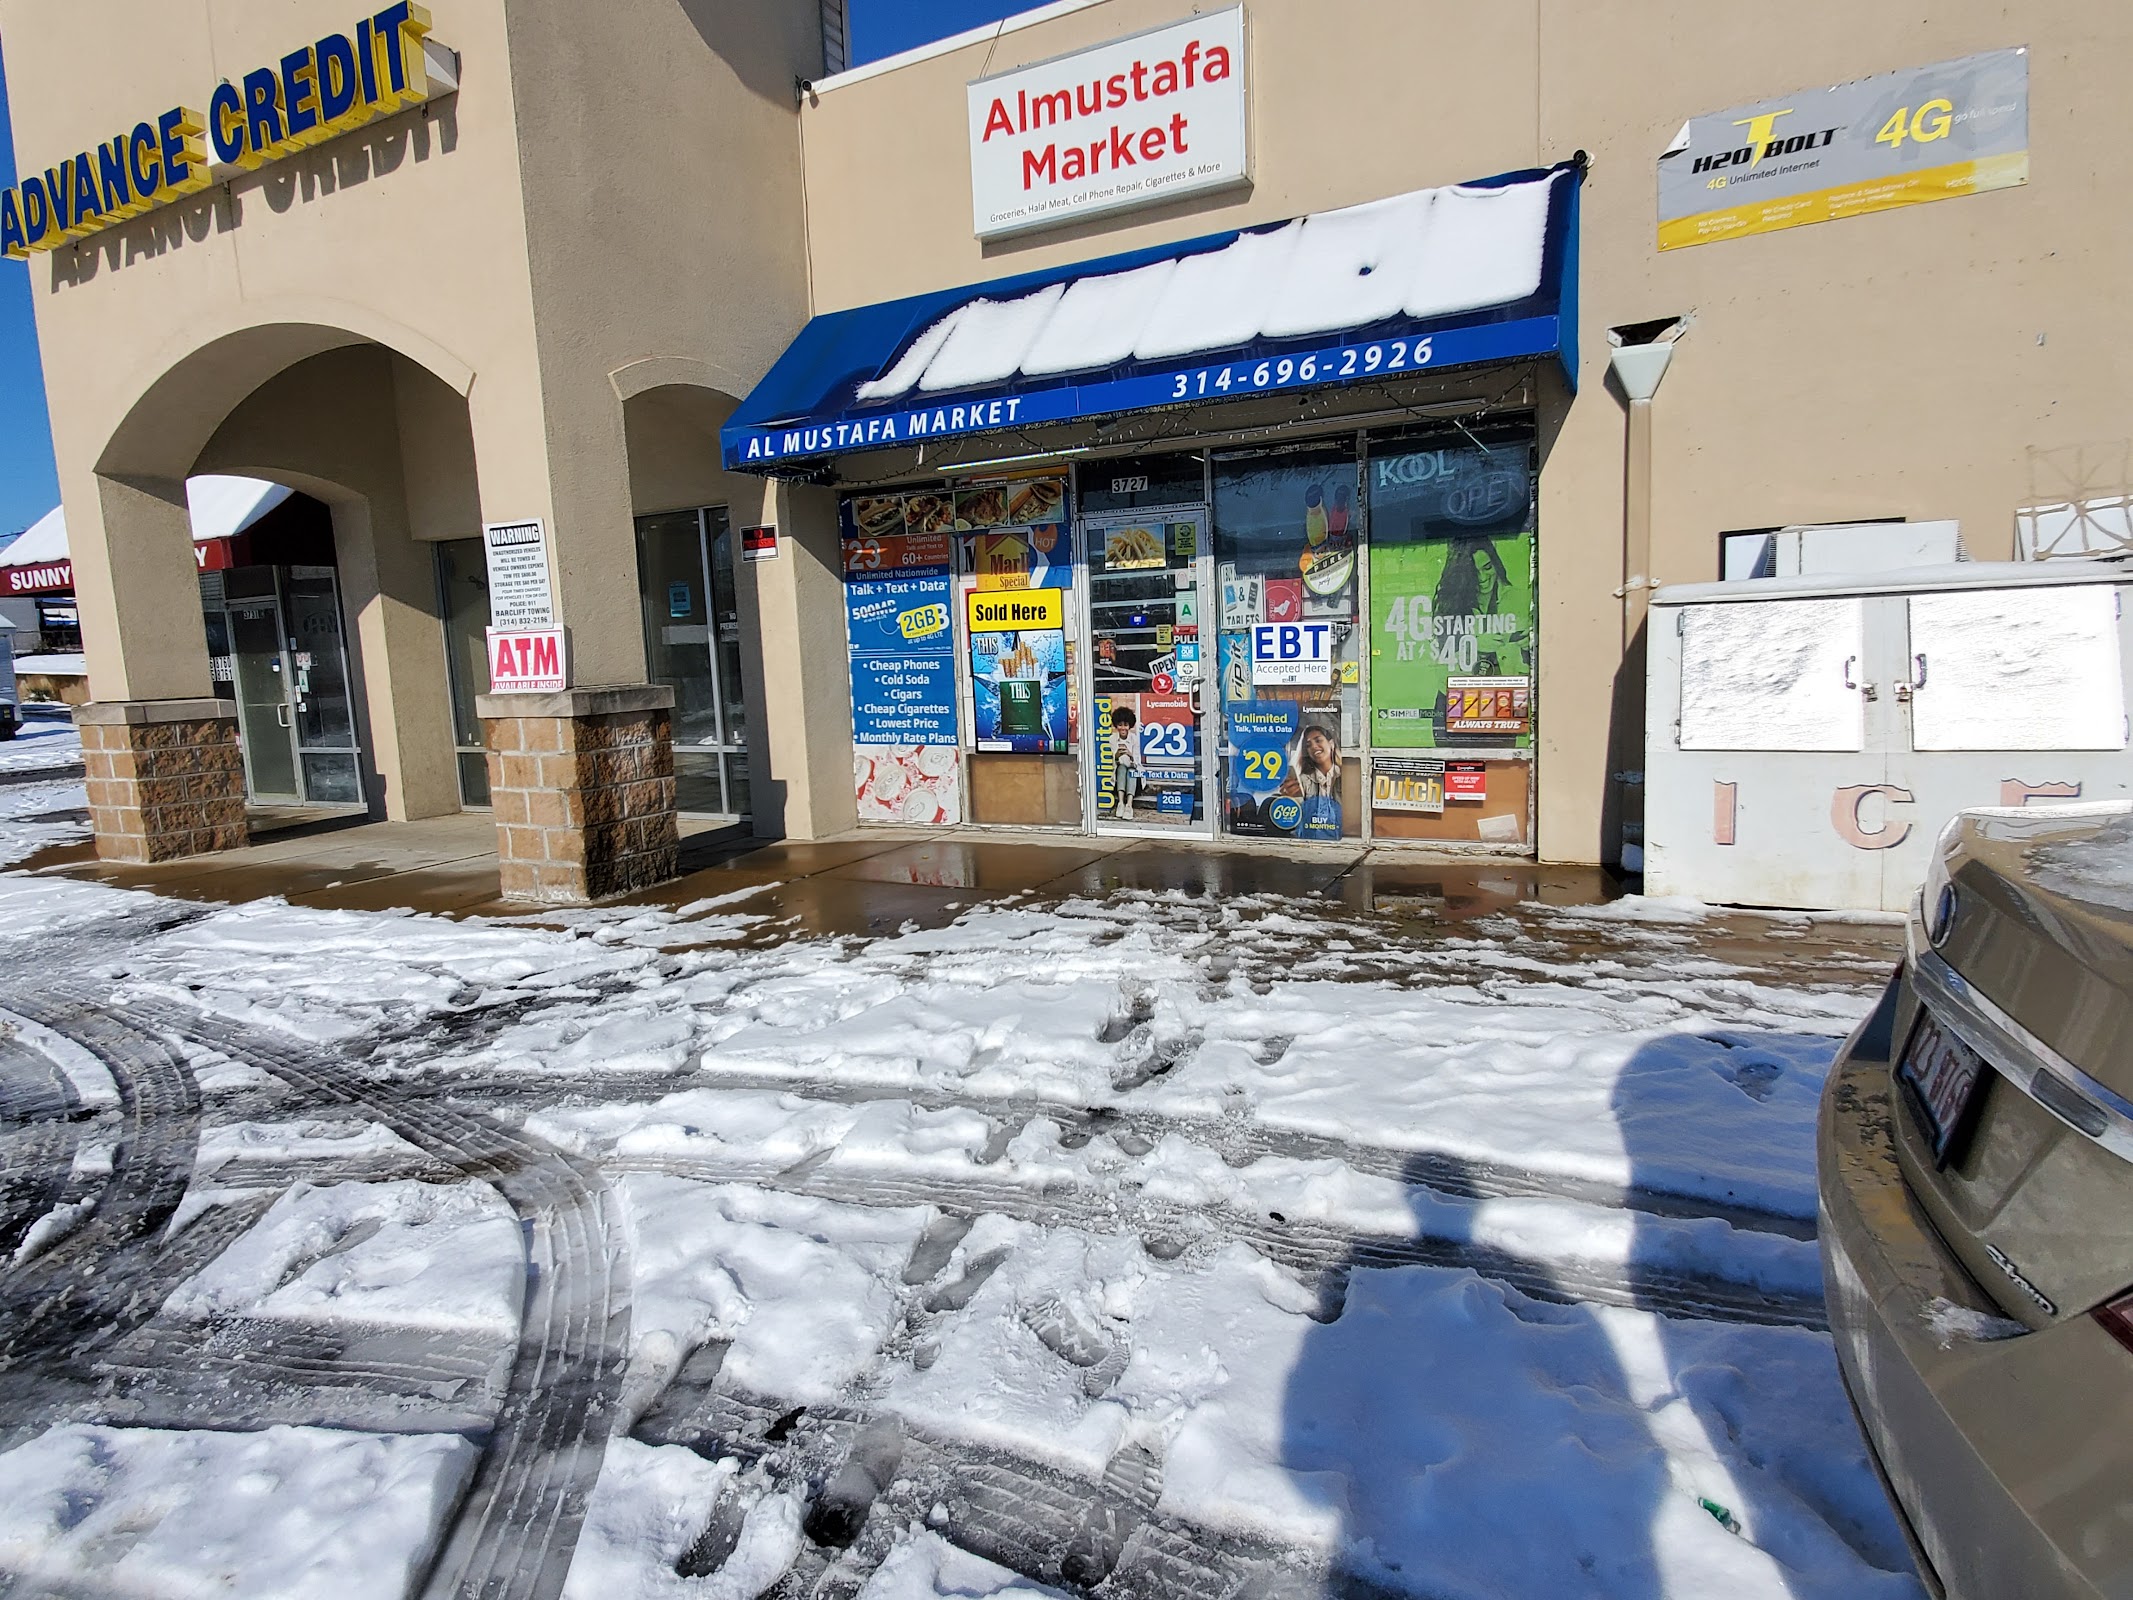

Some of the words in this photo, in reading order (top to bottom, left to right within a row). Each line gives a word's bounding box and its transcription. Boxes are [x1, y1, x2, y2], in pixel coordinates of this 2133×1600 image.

[982, 40, 1230, 143] Almustafa
[0, 105, 192, 257] ADVANCE
[209, 3, 412, 165] CREDIT
[1875, 99, 1953, 148] 4G
[1763, 127, 1839, 158] BOLT
[1023, 113, 1188, 191] Market
[1706, 176, 1727, 190] 4G
[1729, 168, 1777, 185] Unlimited
[1779, 159, 1820, 175] Internet
[990, 207, 1027, 223] Groceries,
[1028, 200, 1047, 214] Halal
[1049, 197, 1072, 209] Meat,
[1073, 191, 1087, 203] Cell
[1089, 187, 1114, 200] Phone
[1116, 181, 1144, 195] Repair,
[1145, 170, 1187, 189] Cigarettes
[1188, 167, 1195, 177] &
[1198, 162, 1221, 174] More
[1172, 337, 1433, 398] 314-696-2926
[747, 436, 775, 459] AL
[783, 418, 896, 453] MUSTAFA
[908, 398, 1022, 436] MARKET
[1378, 451, 1457, 488] KOOL
[1113, 477, 1146, 492] 3727
[1448, 477, 1525, 514] OPEN
[490, 524, 540, 546] WARNING
[907, 535, 942, 544] Unlimited
[1035, 538, 1055, 549] HOT
[902, 552, 923, 565] 60+
[1314, 553, 1343, 573] PURE
[10, 566, 71, 591] SUNNY
[856, 571, 893, 580] Unlimited
[895, 567, 939, 579] Nationwide
[850, 583, 874, 596] Talk
[885, 583, 909, 594] Text
[910, 583, 917, 591] +
[1000, 575, 1028, 590] Special
[1239, 587, 1244, 601] &
[495, 608, 526, 617] BARCLIFF
[527, 607, 550, 615] TOWING
[976, 604, 1007, 621] Sold
[1012, 603, 1047, 620] Here
[1182, 604, 1191, 616] A
[500, 618, 517, 627] (314)
[904, 609, 936, 632] 2GB
[1385, 595, 1433, 641] 4G
[1434, 614, 1516, 635] STARTING
[976, 637, 998, 655] THIS
[1174, 635, 1198, 645] PULL
[1256, 625, 1328, 659] EBT
[495, 637, 560, 677] ATM
[1231, 640, 1241, 659] it
[1397, 642, 1416, 661] AT
[1430, 635, 1478, 672] $40
[870, 660, 901, 673] Cheap
[904, 659, 941, 670] Phones
[1153, 656, 1175, 675] OPEN
[1256, 664, 1302, 674] Accepted
[1304, 664, 1327, 673] Here
[537, 680, 562, 689] INSIDE
[881, 674, 903, 685] Cold
[905, 674, 930, 685] Soda
[890, 689, 922, 702] Cigars
[1010, 683, 1030, 699] THIS
[864, 704, 895, 716] Cheap
[898, 704, 949, 716] Cigarettes
[1147, 699, 1187, 708] Lycamobile
[1302, 703, 1337, 713] Lycamobile
[1234, 713, 1287, 724] Unlimited
[1390, 710, 1418, 718] SIMPLE
[1419, 709, 1444, 718] Mobile
[876, 718, 911, 728] Lowest
[913, 718, 939, 728] Price
[1234, 725, 1251, 733] Talk,
[1275, 725, 1292, 733] Data
[1453, 721, 1493, 729] ALWAYS
[1494, 721, 1521, 729] TRUE
[860, 732, 901, 744] Monthly
[903, 733, 926, 743] Rate
[929, 733, 956, 743] Plans
[1095, 699, 1115, 808] Unlimited
[1375, 775, 1441, 803] Dutch
[1163, 796, 1181, 804] 2GB
[1273, 805, 1298, 820] 6GB
